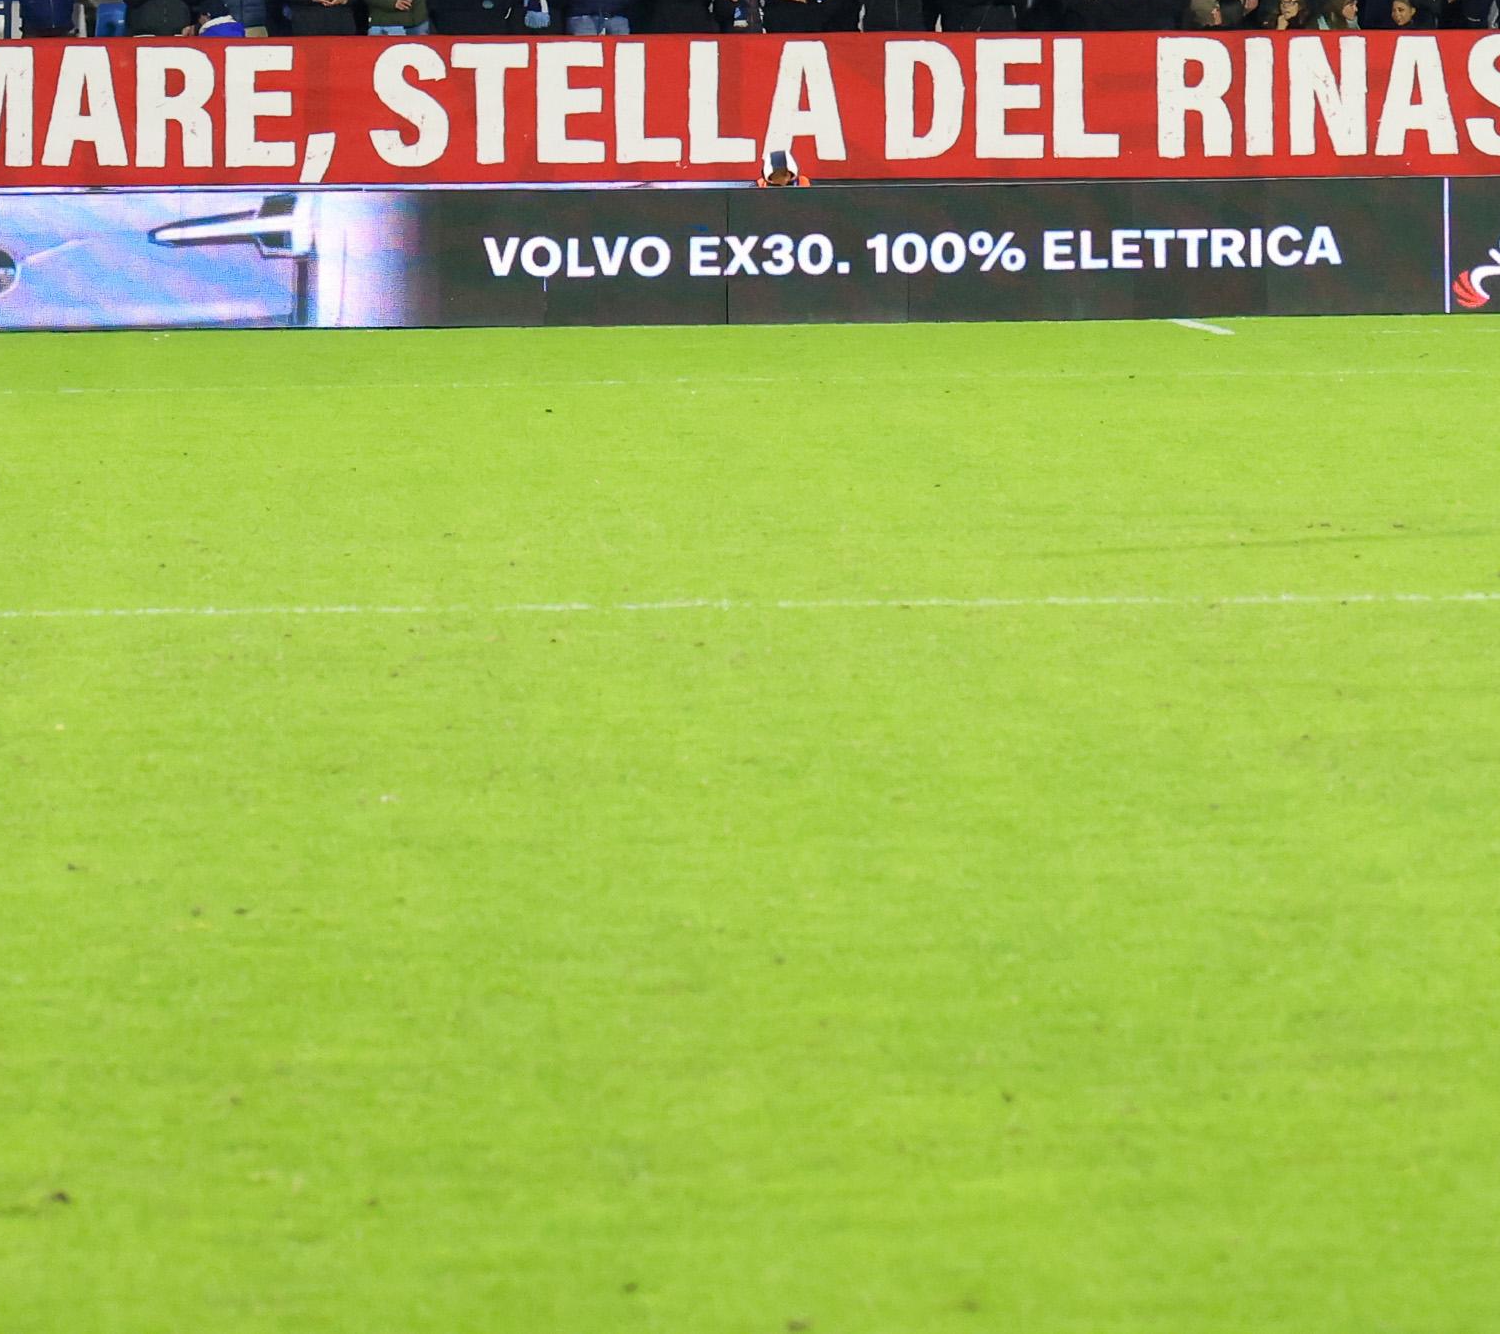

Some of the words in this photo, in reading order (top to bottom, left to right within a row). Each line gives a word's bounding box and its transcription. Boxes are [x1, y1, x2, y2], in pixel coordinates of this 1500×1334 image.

[369, 39, 846, 167] STELLA
[885, 35, 1120, 161] DEL
[482, 231, 671, 279] VOLVO
[689, 228, 851, 278] EX30.
[866, 227, 1026, 276] 100%
[1043, 224, 1342, 271] ELETTRICA
